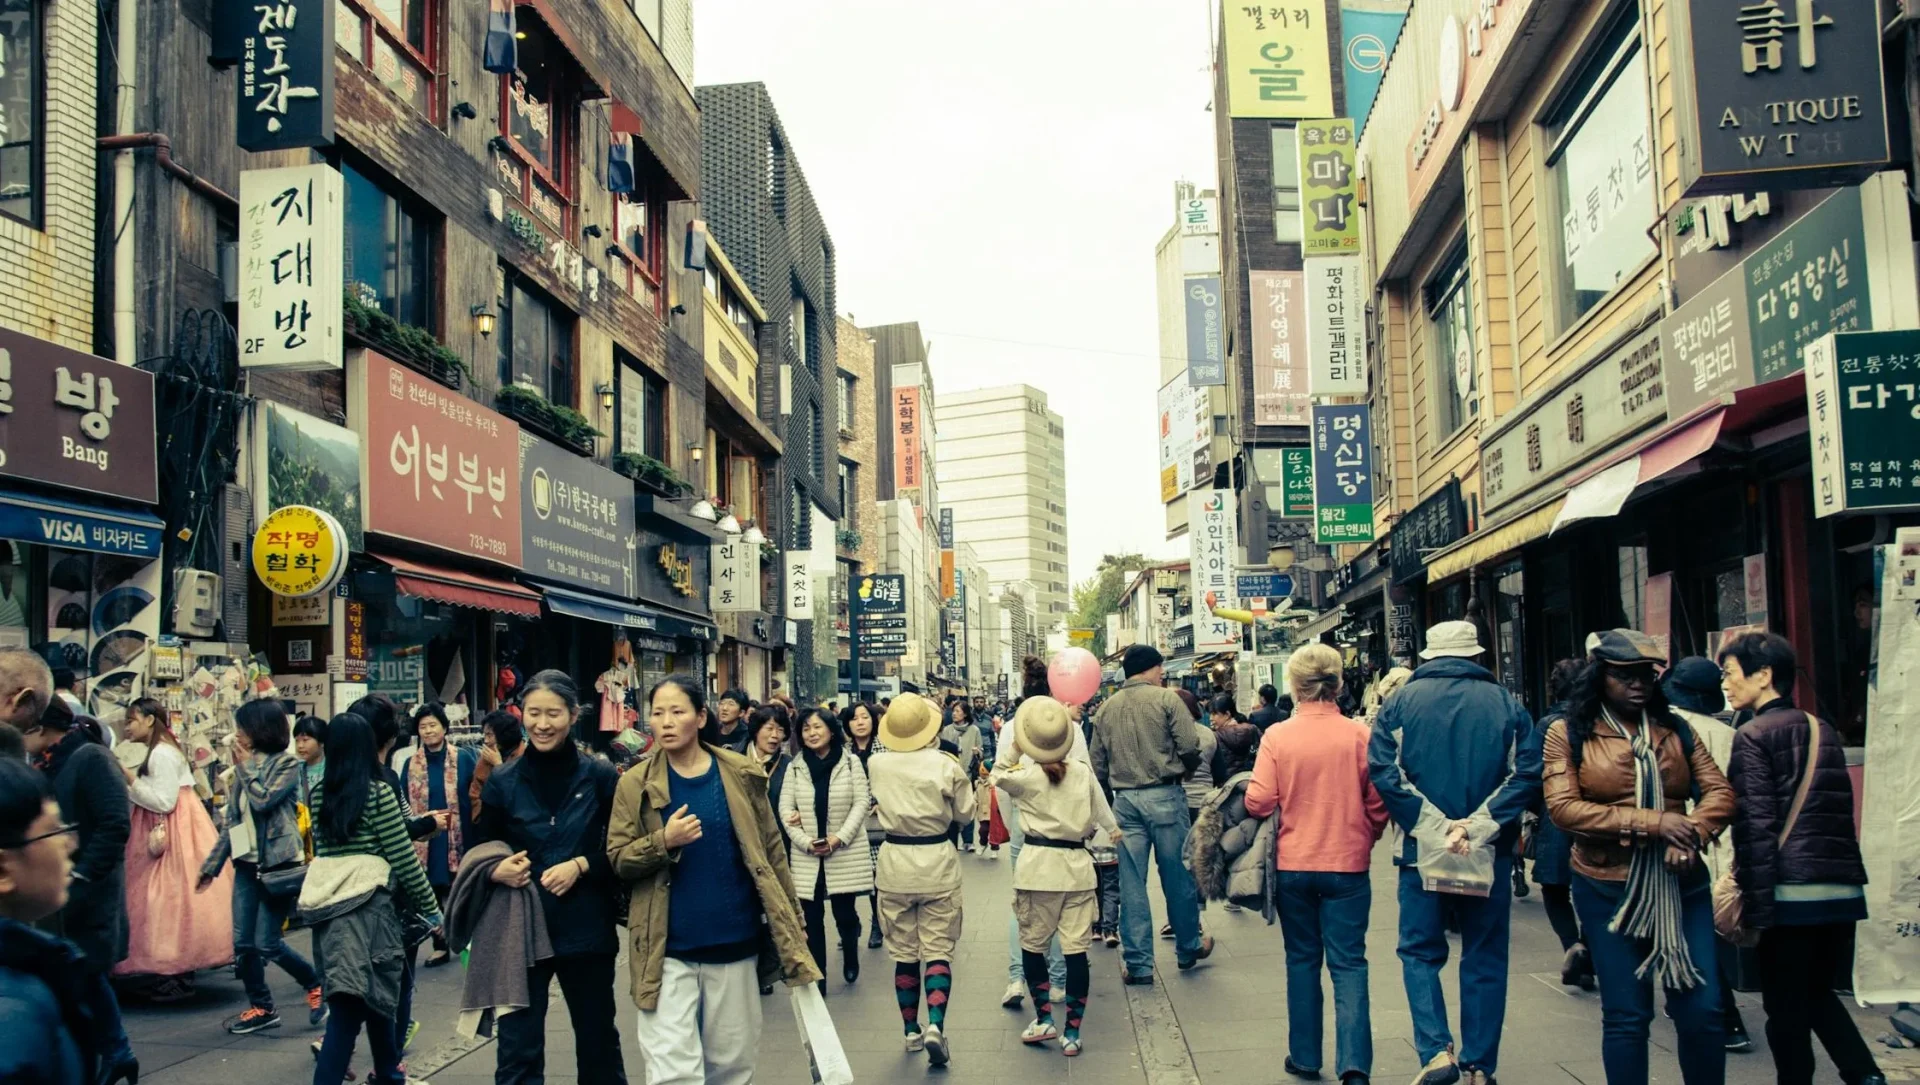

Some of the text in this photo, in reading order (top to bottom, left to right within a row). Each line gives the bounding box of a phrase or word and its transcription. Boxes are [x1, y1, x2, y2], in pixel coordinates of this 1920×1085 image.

[1242, 6, 1310, 29] 갤러리
[1306, 127, 1348, 144] 옥션
[1313, 156, 1347, 224] 마니
[247, 201, 268, 309] 전통찻집
[1307, 237, 1358, 248] 고미술 2F
[271, 178, 313, 350] 지대방
[1757, 238, 1850, 323] 다경향실
[1265, 279, 1292, 289] 제2회
[1327, 267, 1347, 382] 평화아트갤러리
[1673, 297, 1733, 361] 평화아트
[245, 338, 264, 354] 2F
[1690, 336, 1737, 393] 갤러리
[899, 394, 914, 435] 노학봉
[1317, 416, 1328, 452] 도서출판
[62, 436, 108, 471] Bang
[1333, 415, 1367, 496] 명신당
[1850, 460, 1901, 473] 작설차
[1851, 476, 1903, 489] 모과차
[1320, 508, 1347, 522] 월간
[1320, 521, 1372, 537] 아트앤씨
[41, 517, 149, 550] VISA 비자카드
[267, 531, 318, 549] 작명
[266, 553, 322, 573] 철학
[719, 544, 735, 604] 인사동
[1205, 512, 1229, 637] (주)인사아트프자
[340, 584, 349, 596] 33
[792, 563, 807, 608] 옛찻집
[874, 588, 901, 606] 마루
[876, 578, 899, 589] 인사동
